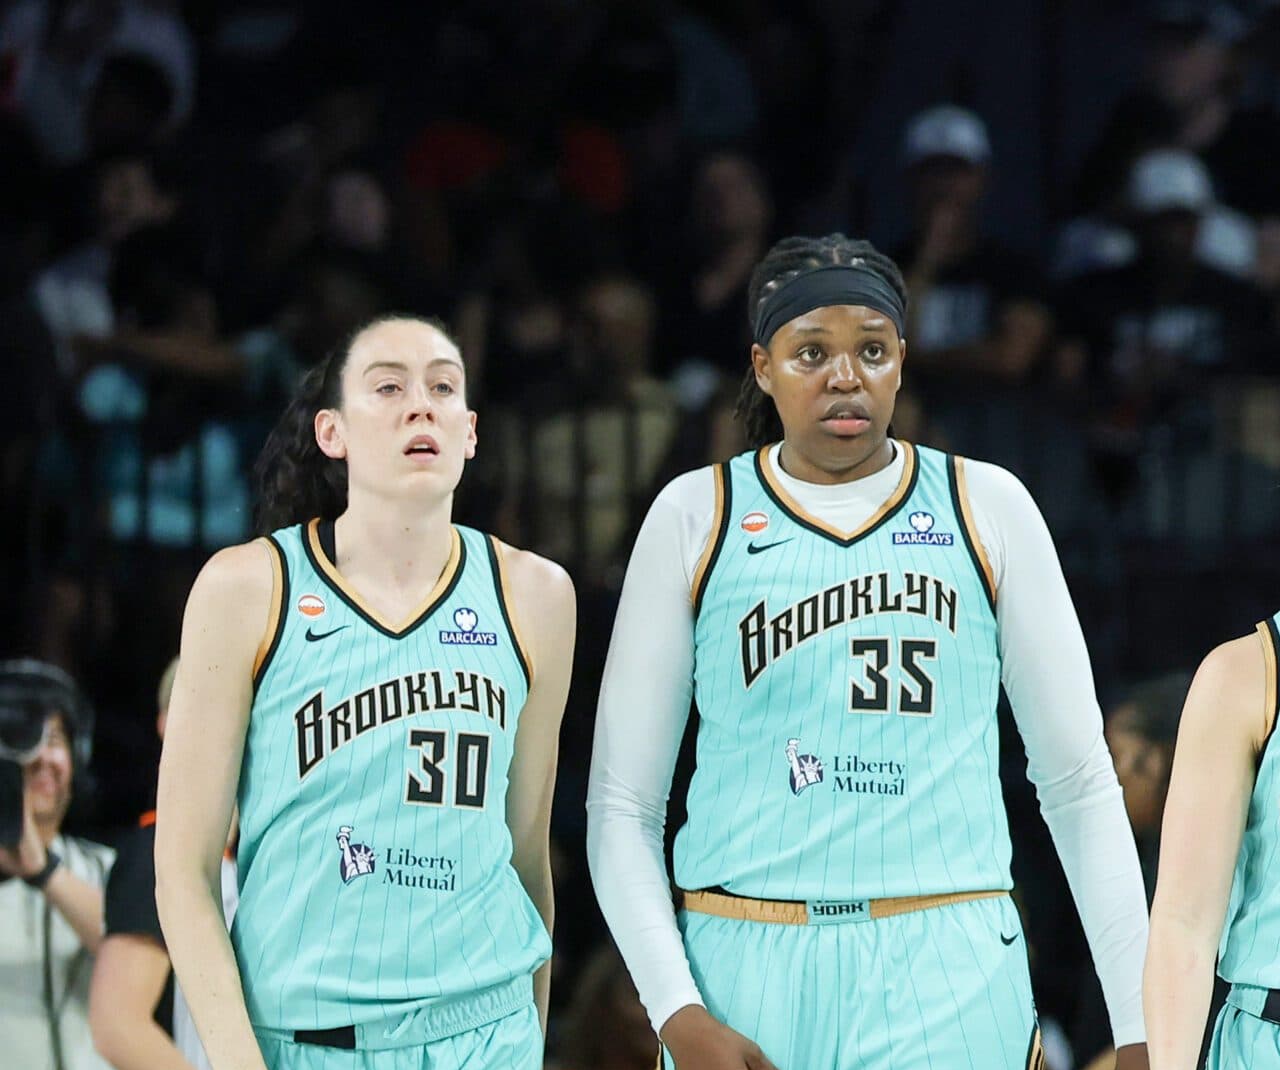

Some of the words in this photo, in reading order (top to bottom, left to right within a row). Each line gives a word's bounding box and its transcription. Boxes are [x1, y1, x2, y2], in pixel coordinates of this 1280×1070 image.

[893, 533, 953, 545] BARCLAYS
[440, 632, 496, 645] BARCLAYS
[738, 572, 957, 689] BROOKLYN
[848, 636, 937, 716] 35
[294, 671, 506, 781] BROOKLYN
[405, 729, 490, 809] 30
[834, 755, 906, 782] Liberty
[832, 776, 905, 796] Mutual
[386, 848, 457, 877] Liberty
[382, 868, 456, 891] Mutual
[812, 902, 864, 916] YORK
